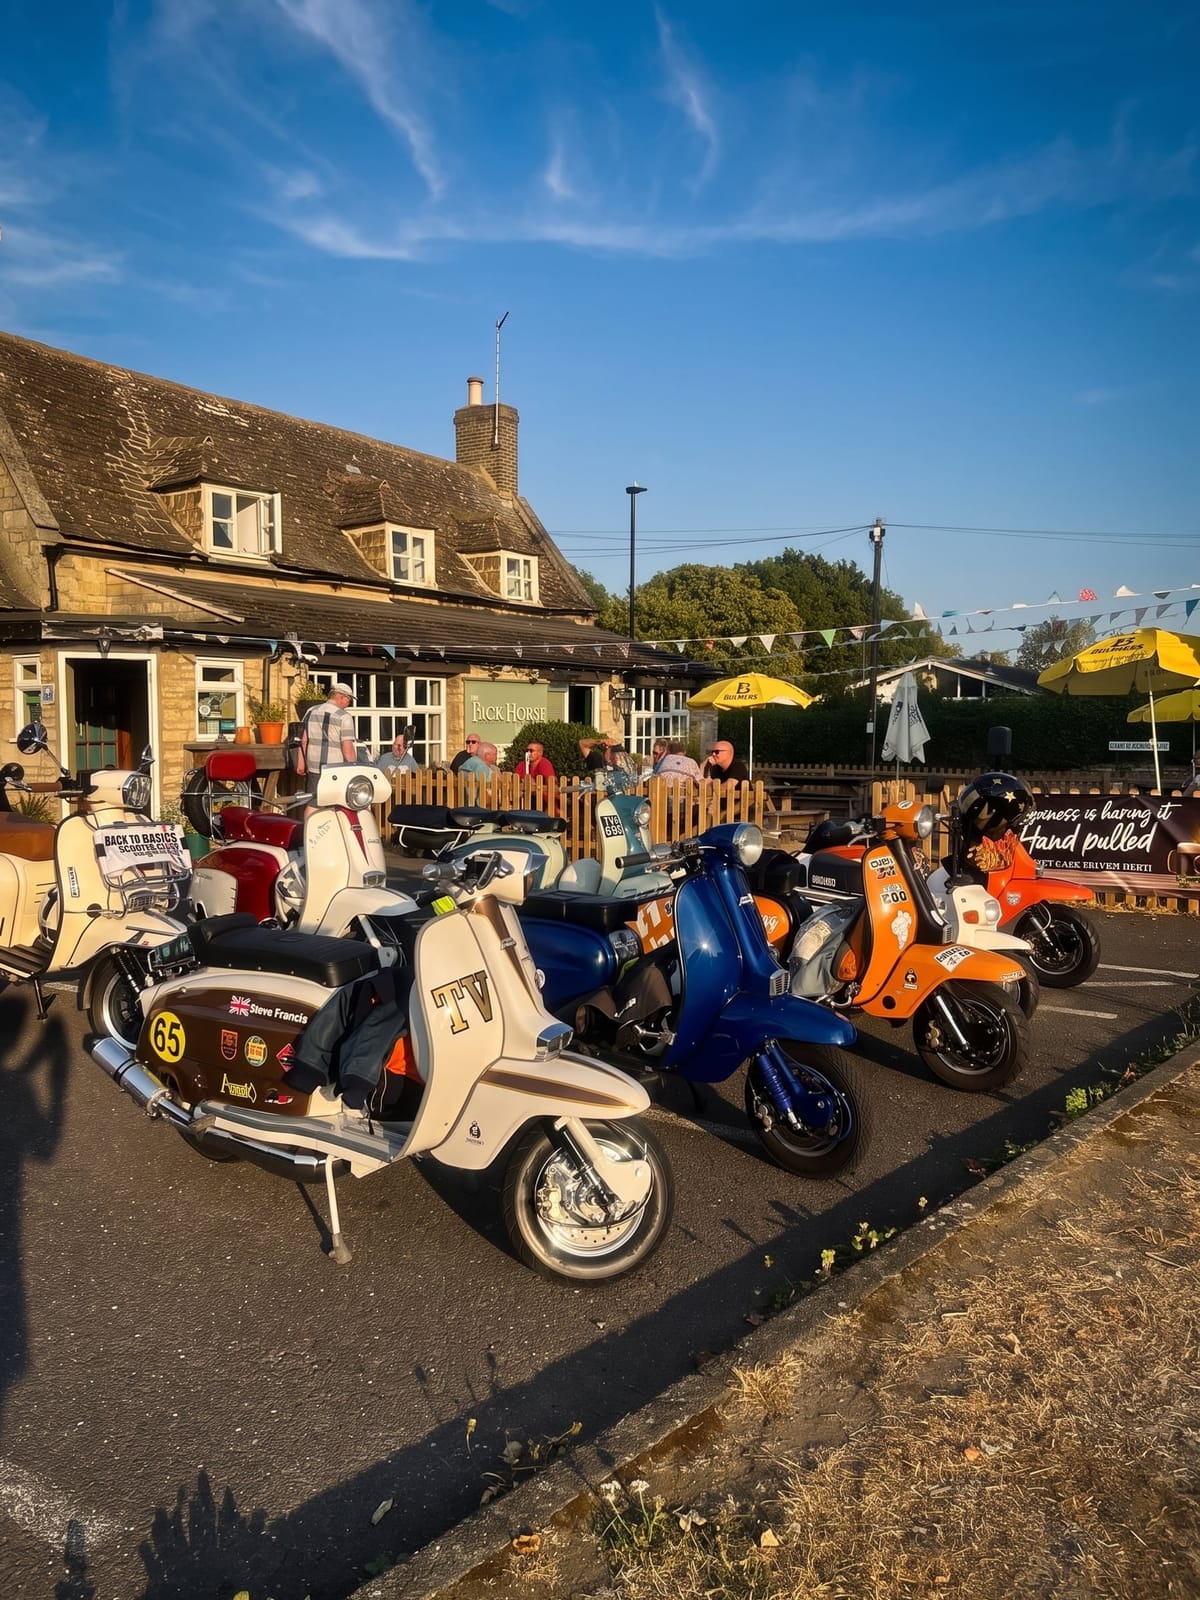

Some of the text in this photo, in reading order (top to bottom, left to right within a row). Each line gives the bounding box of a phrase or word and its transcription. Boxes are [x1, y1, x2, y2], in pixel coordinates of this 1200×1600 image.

[505, 702, 547, 722] HORSE
[1084, 807, 1097, 820] is
[1156, 801, 1183, 822] it
[104, 832, 178, 846] BACK TO BASICS
[1020, 820, 1158, 857] Hand pulled
[430, 969, 493, 1035] TV
[250, 1003, 309, 1025] Steve Francis
[154, 1017, 181, 1057] 65
